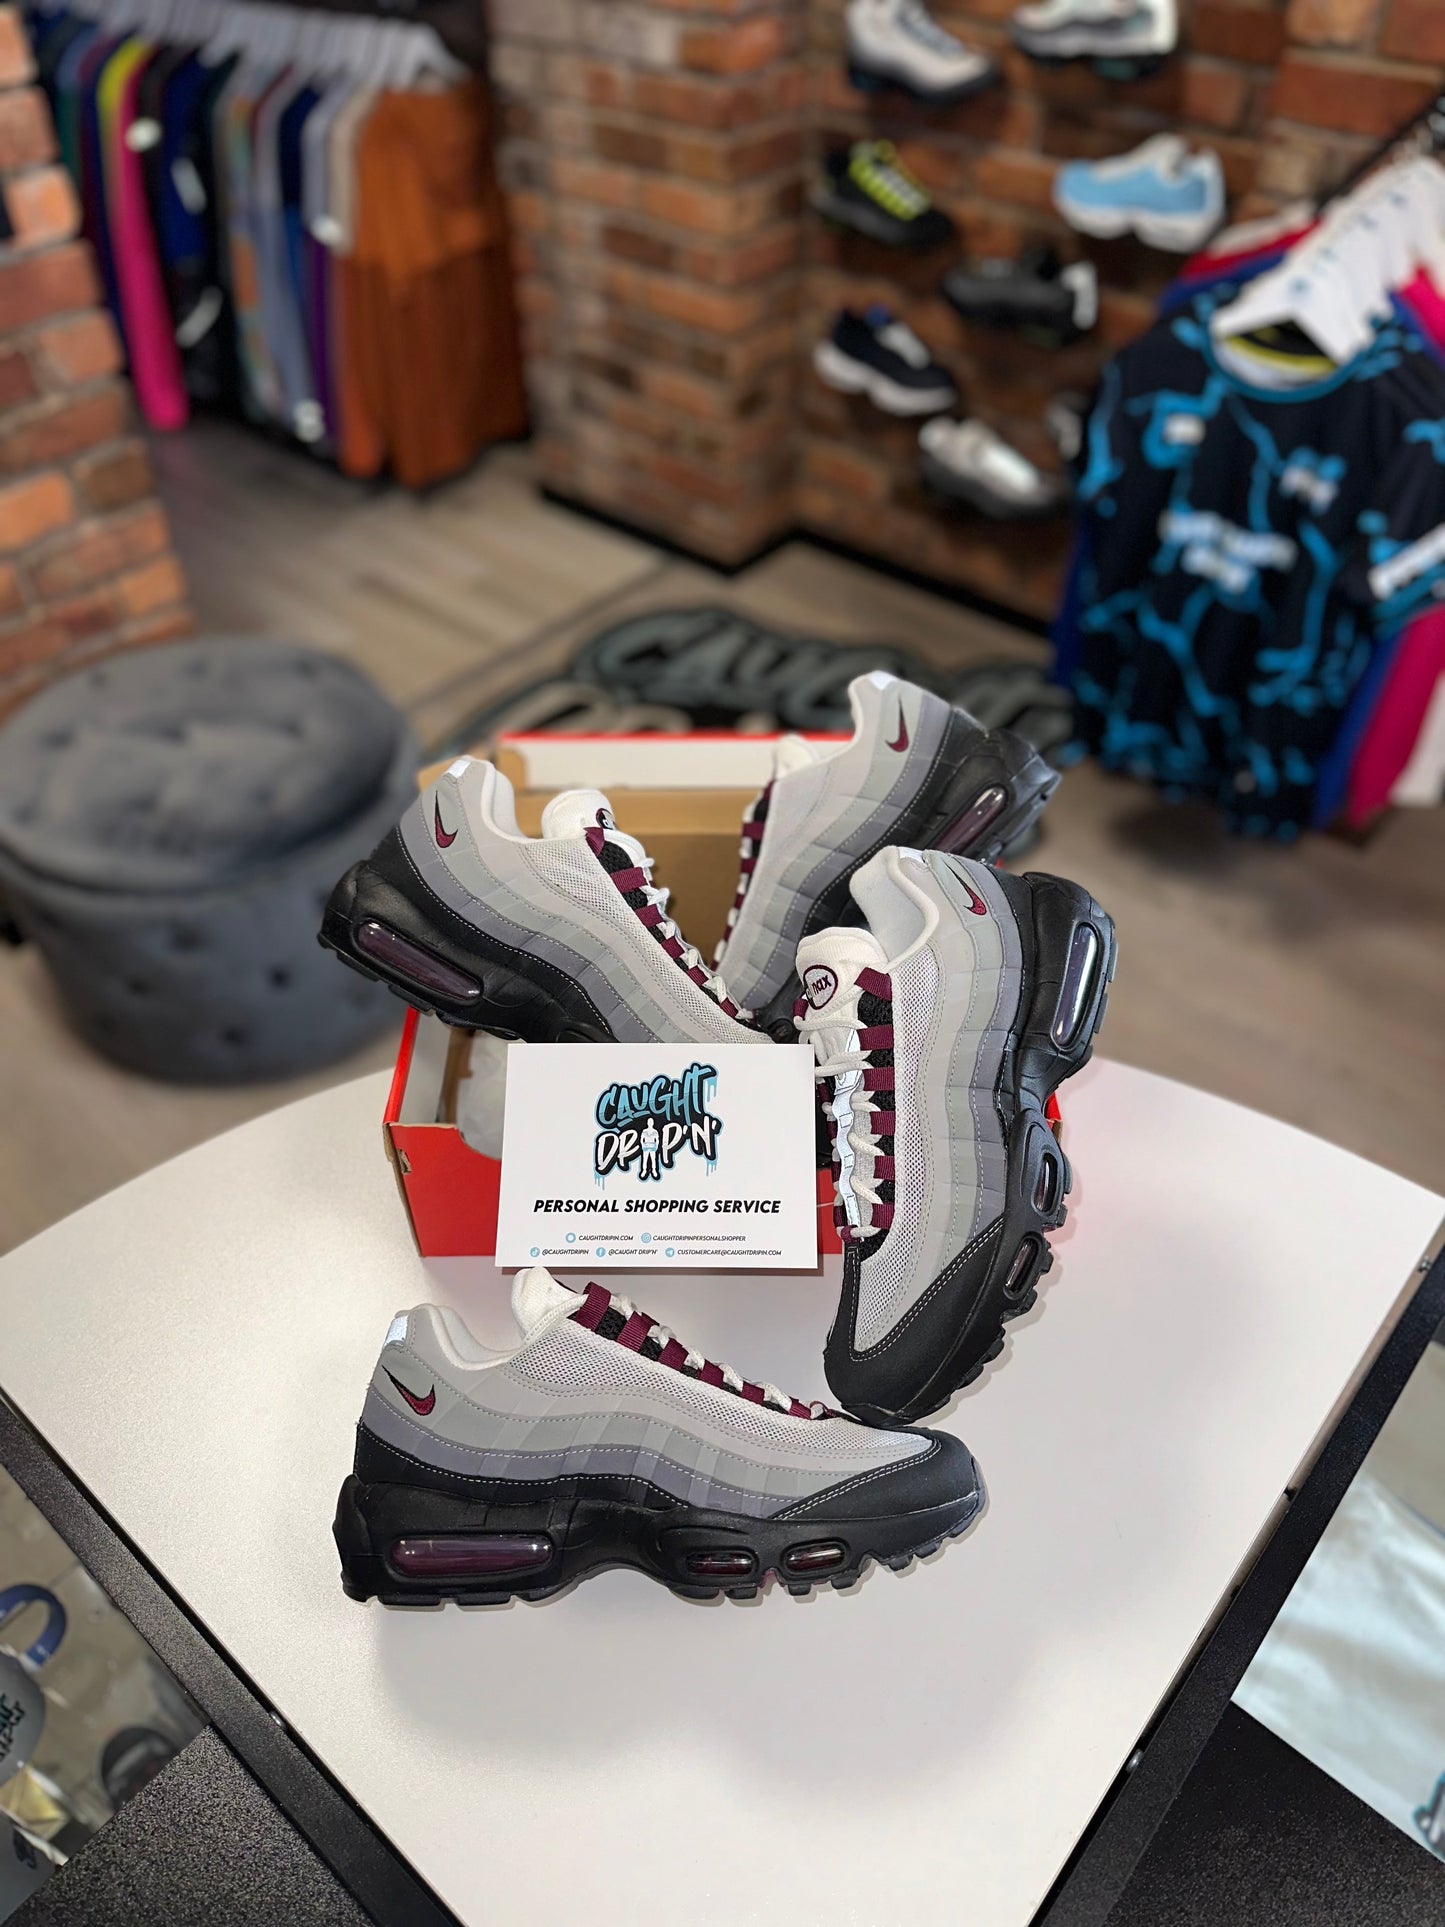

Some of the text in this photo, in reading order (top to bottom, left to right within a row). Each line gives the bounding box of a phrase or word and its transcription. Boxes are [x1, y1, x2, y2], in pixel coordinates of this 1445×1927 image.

[597, 1063, 714, 1127] CAUGHT
[533, 1199, 781, 1214] PERSONAL SHOPPING SERVICE
